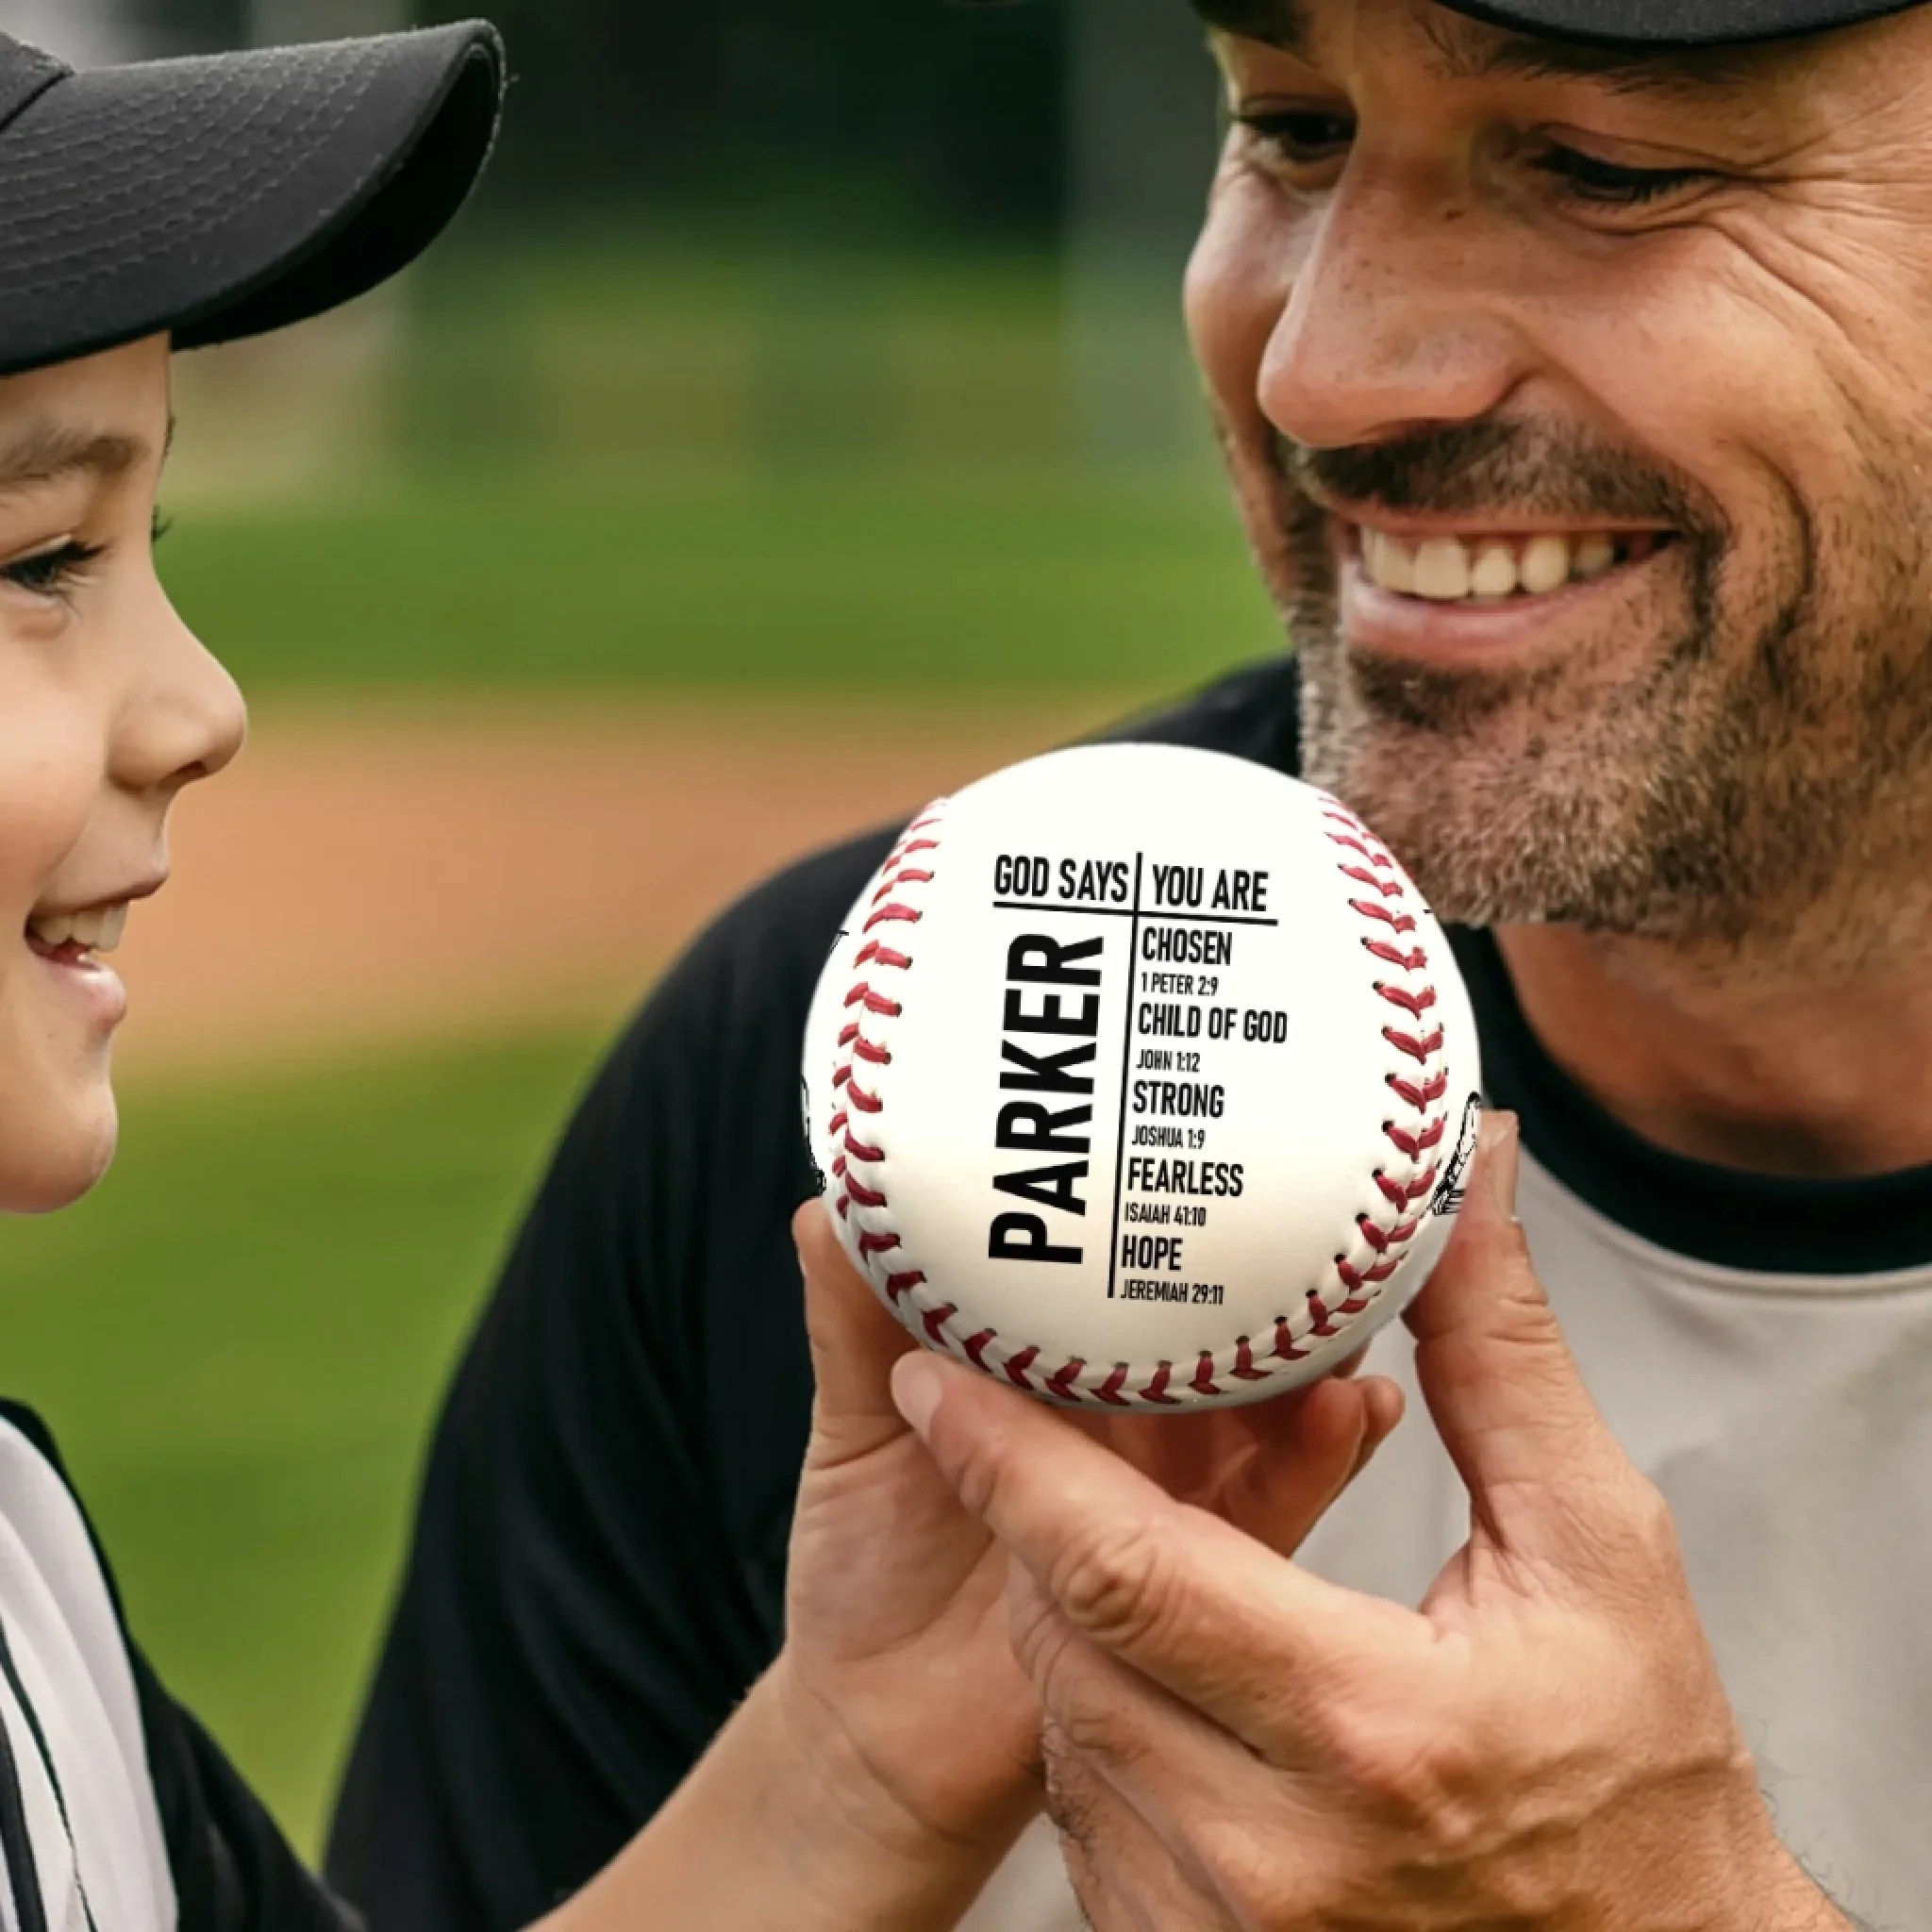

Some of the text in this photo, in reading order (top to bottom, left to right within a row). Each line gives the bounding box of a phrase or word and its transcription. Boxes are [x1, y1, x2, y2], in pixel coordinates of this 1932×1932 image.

[993, 854, 1129, 903] GOD SAYS
[1152, 863, 1269, 912] YOU ARE
[1141, 925, 1233, 967] CHOSEN
[1141, 971, 1220, 997] 1 PETER 2:9
[1137, 1003, 1288, 1044] CHILD OF GOD
[1135, 1048, 1201, 1073] JOHN 1:12
[988, 933, 1105, 1265] PARKER
[1132, 1078, 1225, 1120] STRONG
[1131, 1125, 1207, 1150] JOSHUA 1:9
[1127, 1156, 1244, 1197] FEARLESS
[1124, 1201, 1207, 1227] ISAIAH 41:10
[1120, 1233, 1184, 1273] HOPE
[1120, 1278, 1225, 1307] JEREMIAH 29:11
